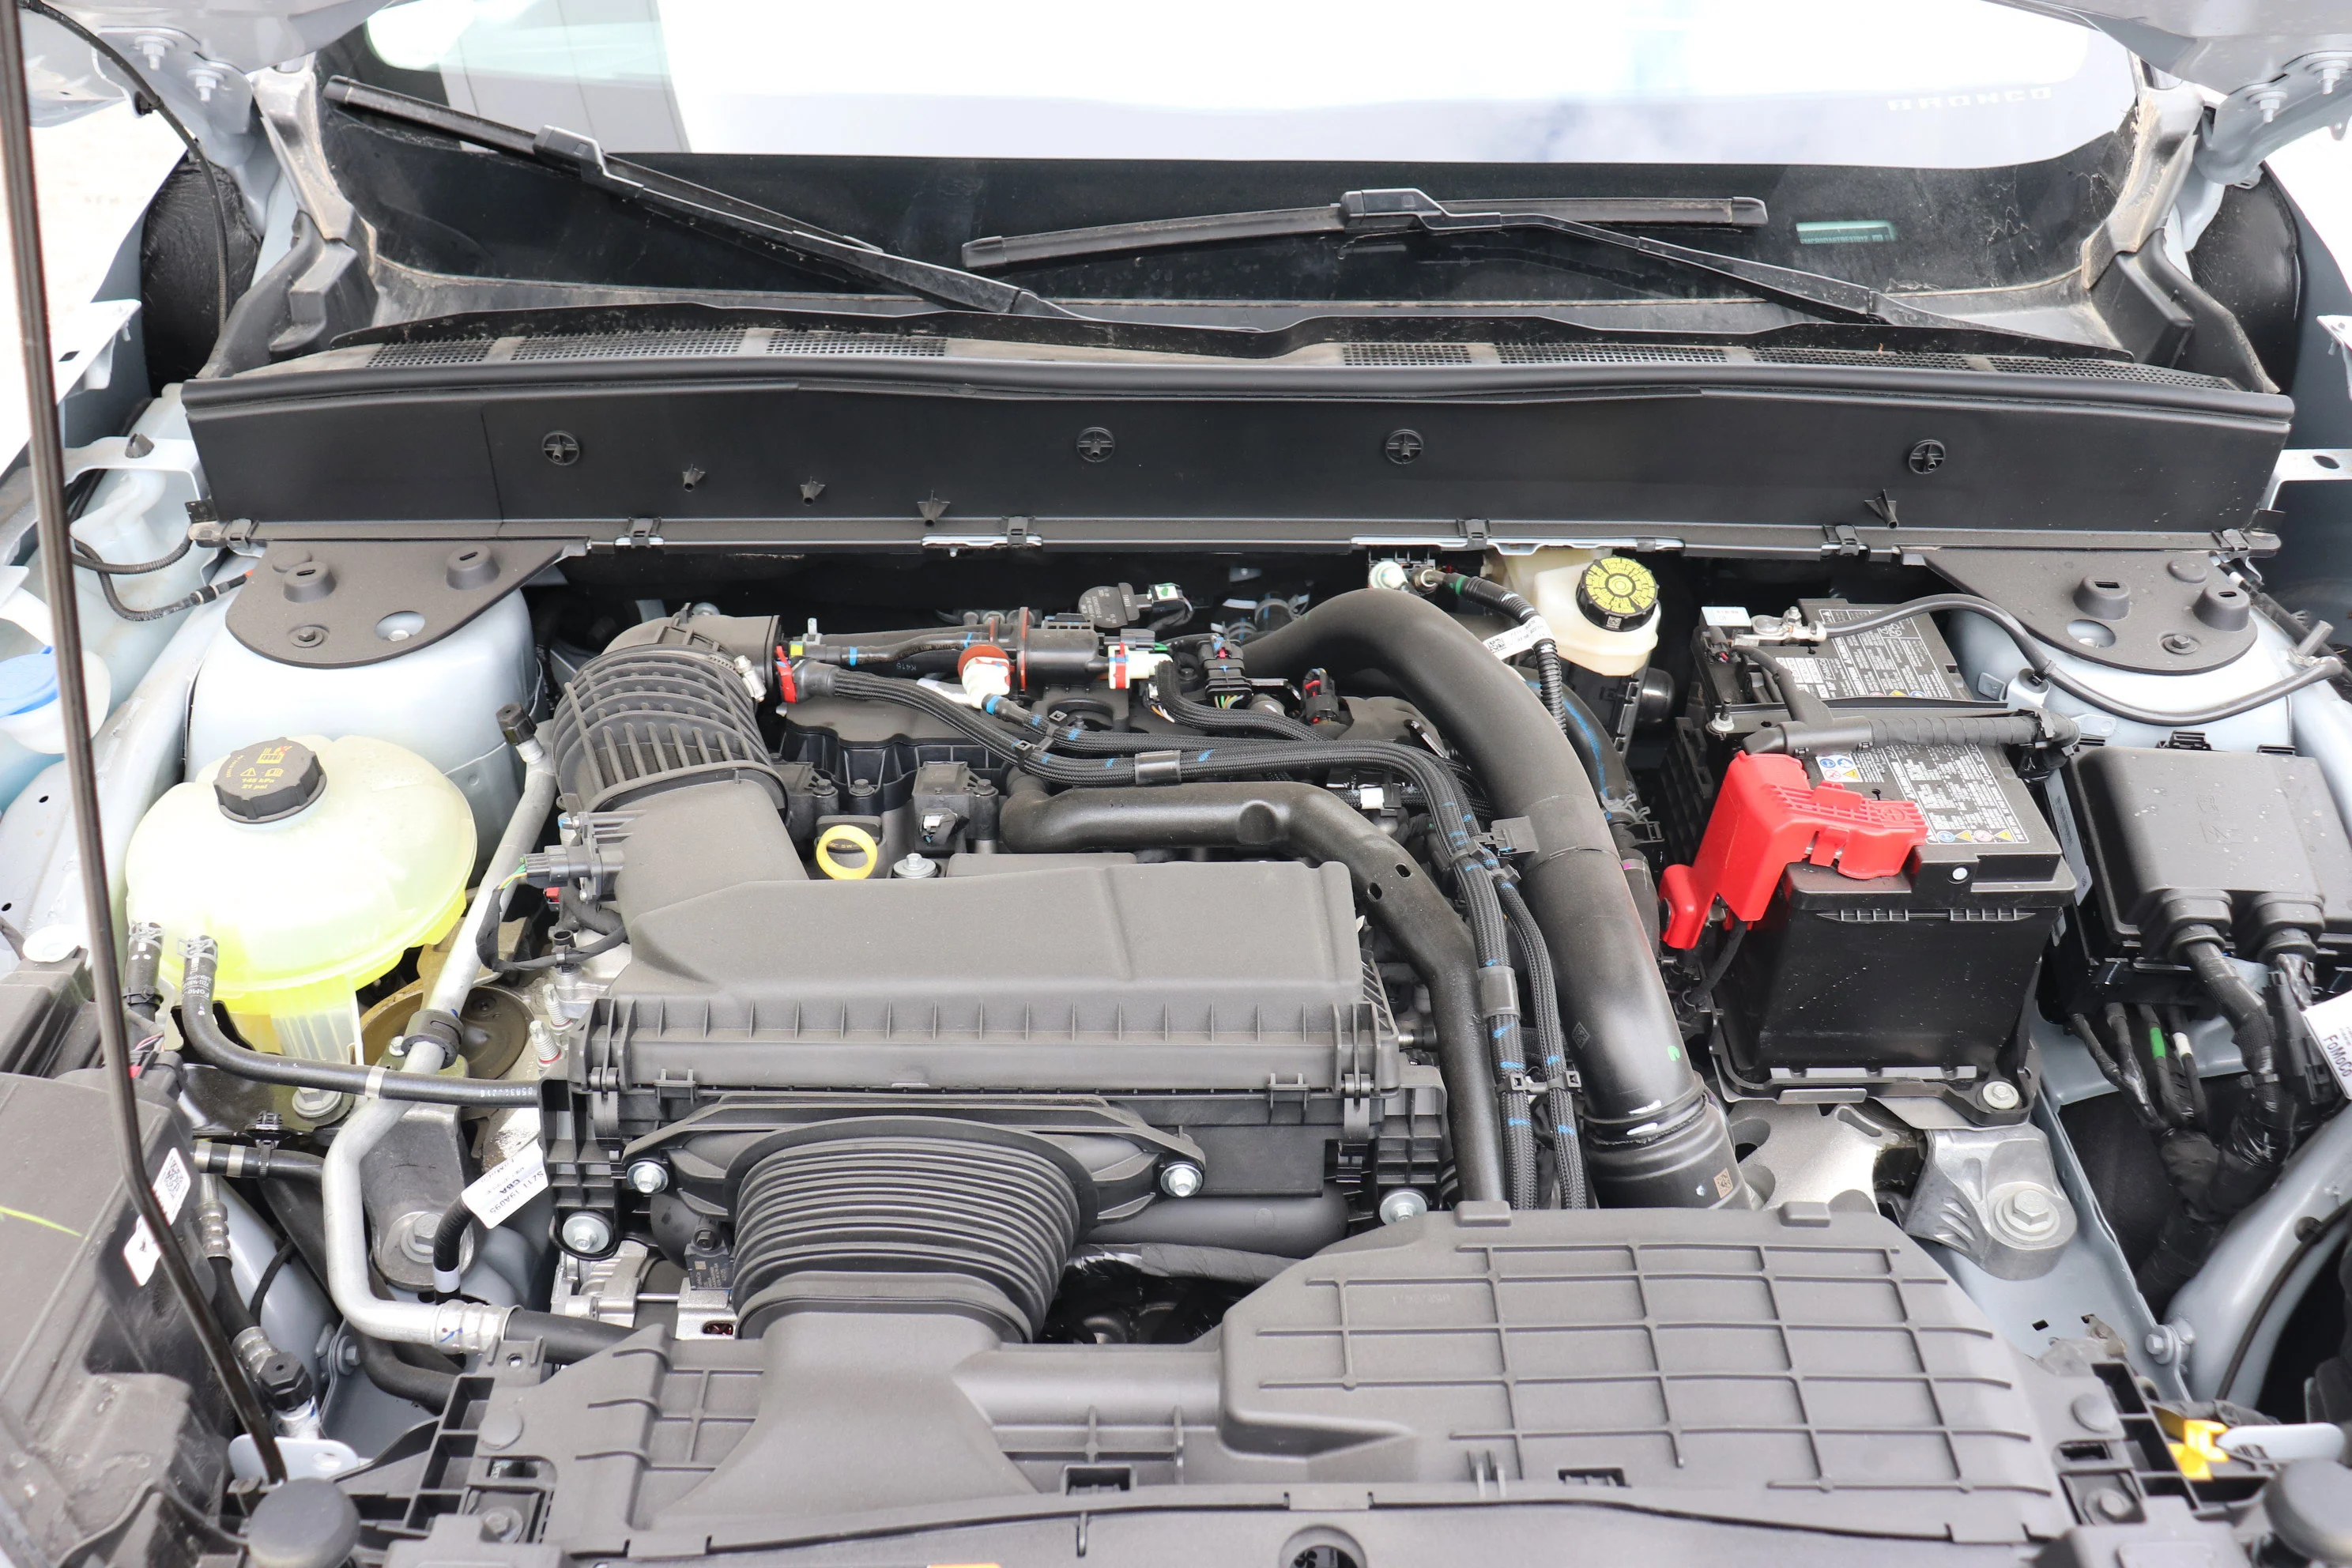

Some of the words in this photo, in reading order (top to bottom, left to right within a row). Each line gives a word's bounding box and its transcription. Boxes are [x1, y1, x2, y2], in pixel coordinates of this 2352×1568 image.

[1887, 87, 2052, 111] BRONCO
[1817, 659, 1834, 678] FoMoCo
[2324, 1035, 2352, 1077] FoMoCo
